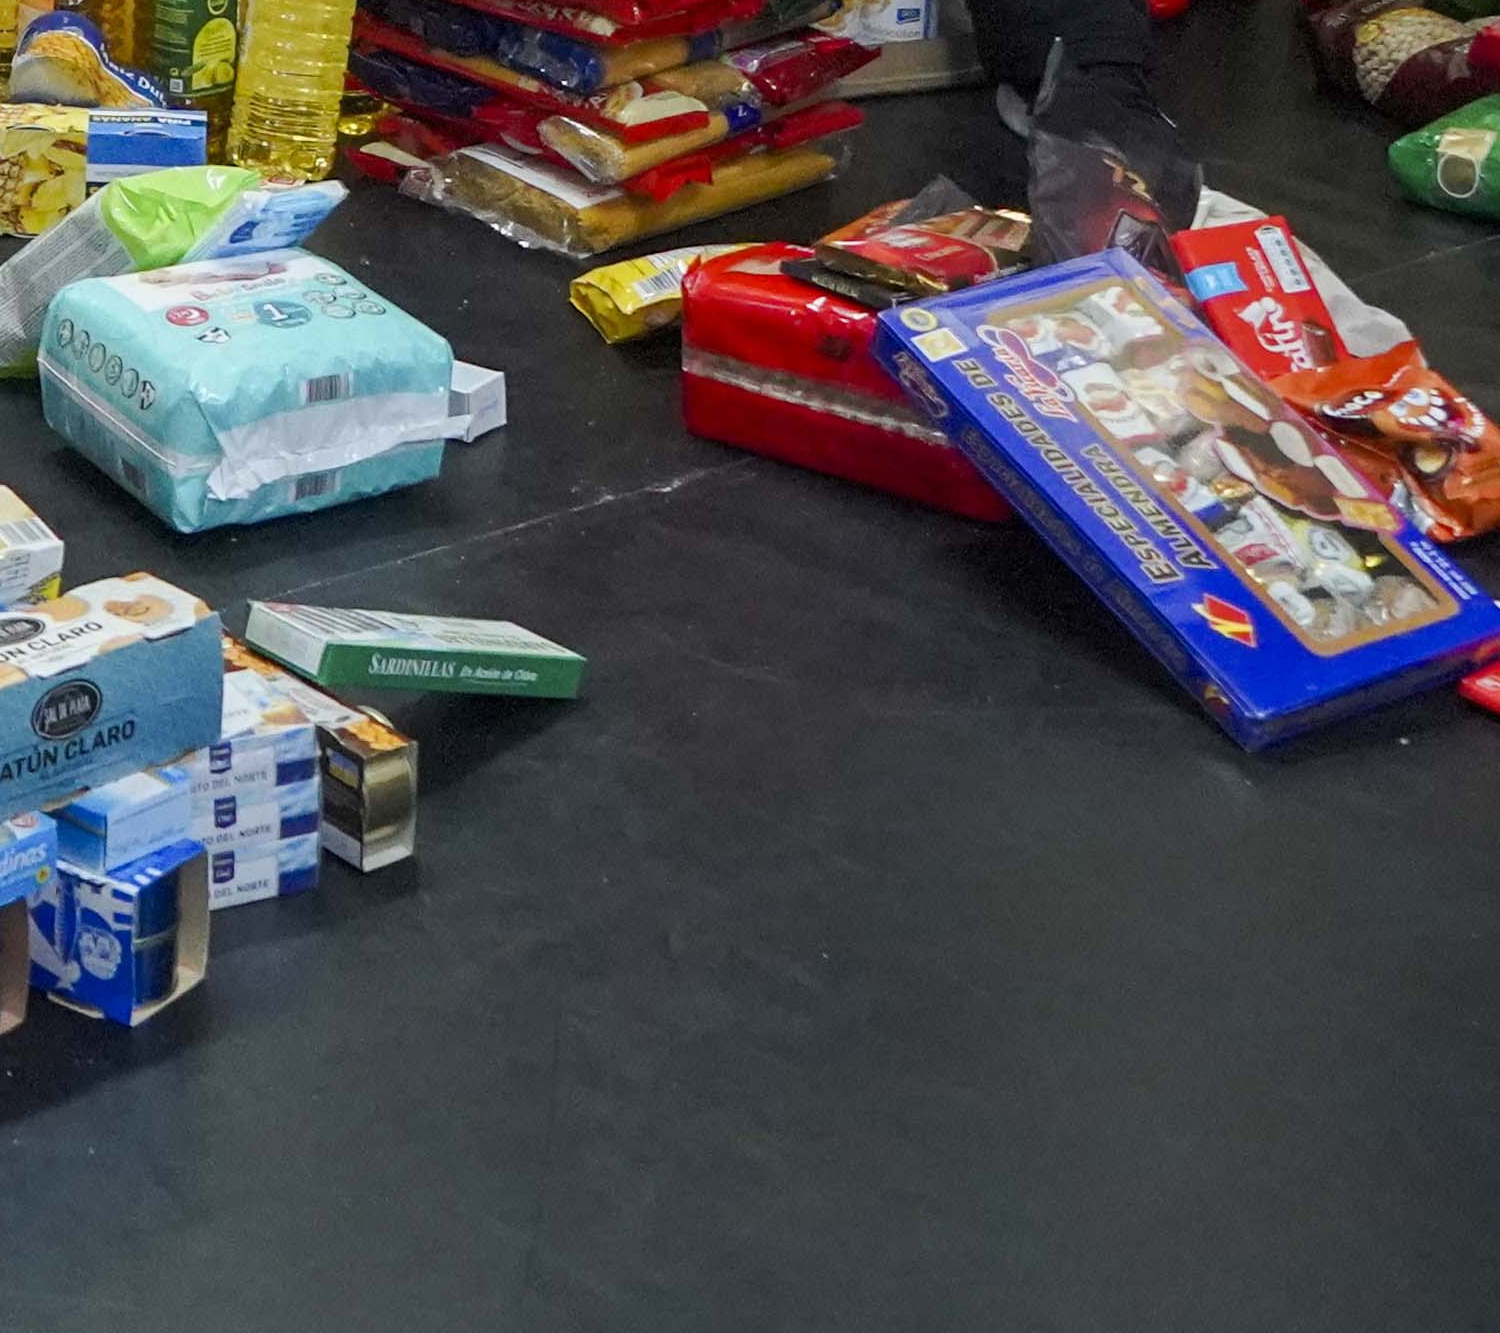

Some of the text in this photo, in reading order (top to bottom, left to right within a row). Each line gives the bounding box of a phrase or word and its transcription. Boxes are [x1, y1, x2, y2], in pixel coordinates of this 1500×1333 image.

[954, 357, 1185, 585] ESPECIALIDADES DE
[1082, 443, 1218, 571] ALMENDRA
[27, 621, 103, 652] CLARO
[368, 652, 455, 678] SARDINILLAS
[0, 719, 136, 781] ATÚN CLARO
[234, 770, 269, 786] NORTE
[237, 823, 271, 838] NORTE
[236, 878, 270, 893] NORTE
